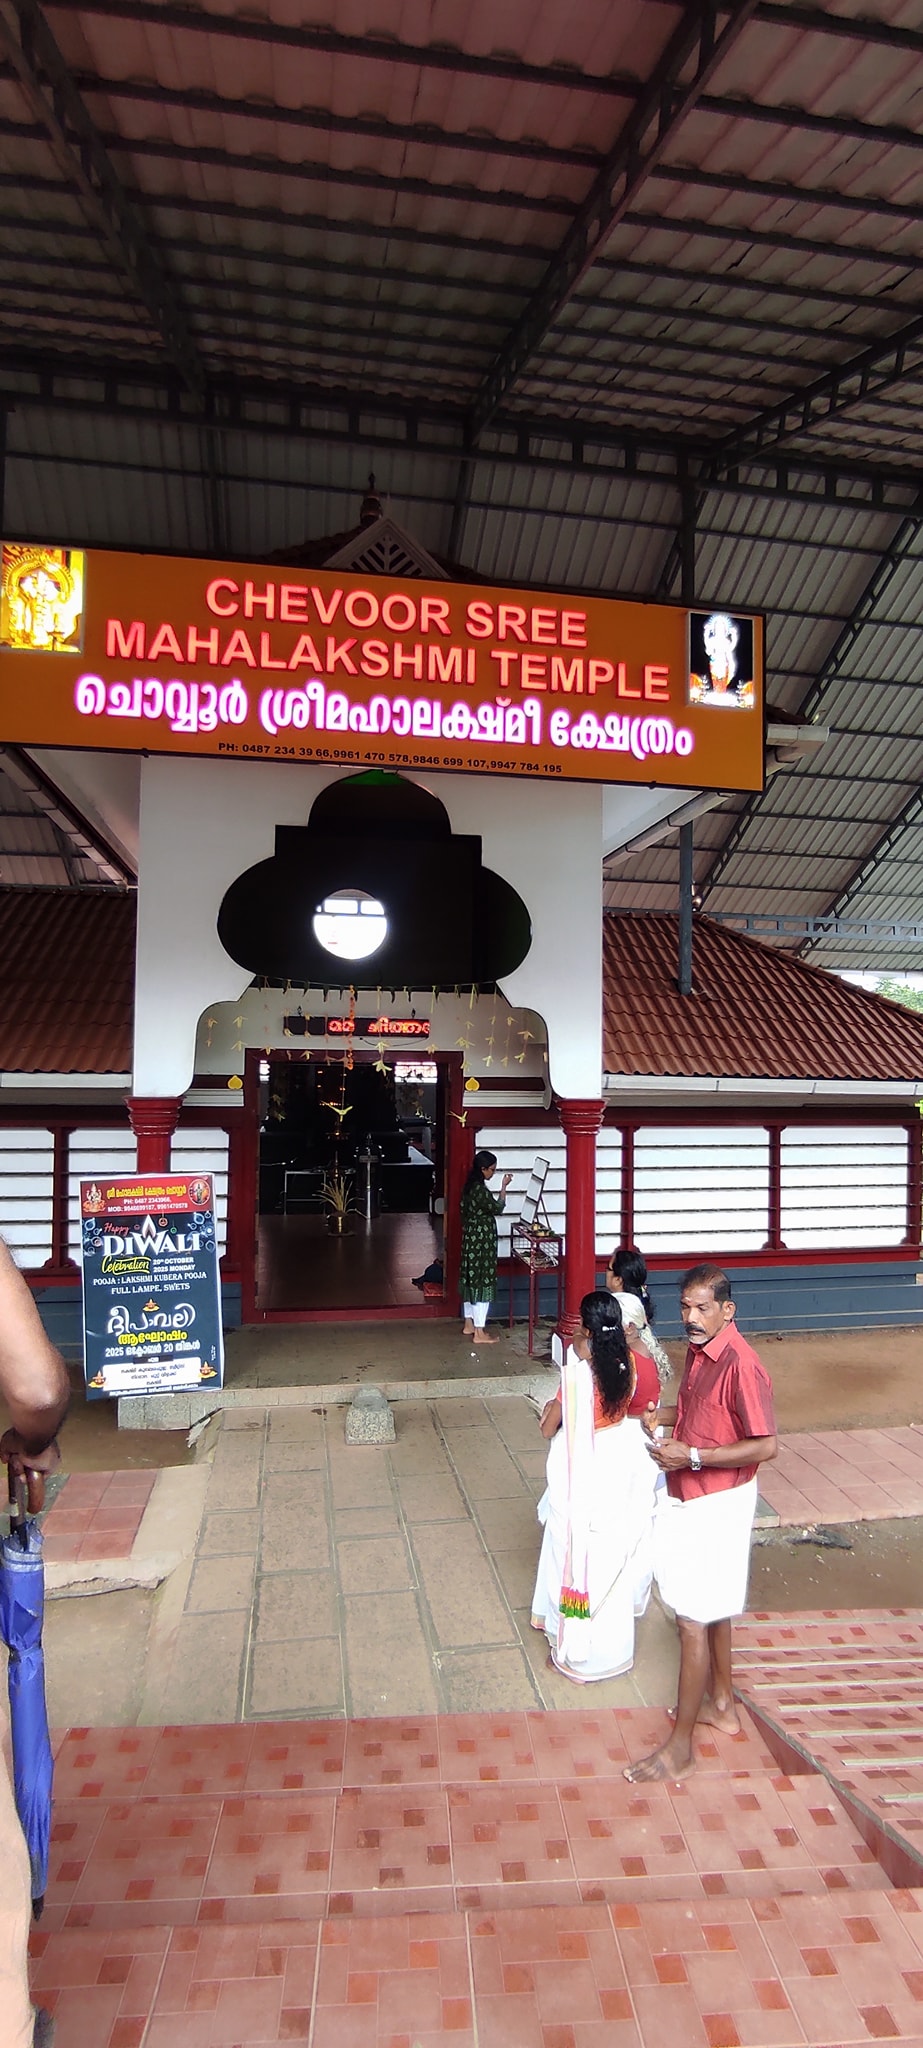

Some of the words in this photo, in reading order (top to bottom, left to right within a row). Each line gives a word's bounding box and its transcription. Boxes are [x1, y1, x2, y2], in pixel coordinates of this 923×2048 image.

[205, 578, 452, 636] CHEVOOR
[465, 601, 588, 648] SREE
[105, 619, 476, 686] MAHALAKSHMI
[490, 649, 671, 702] TEMPLE
[75, 674, 249, 733] ചൊവ്വൂർ
[550, 708, 695, 761] ക്ഷേത്രം
[218, 743, 239, 752] PH:
[242, 745, 271, 754] 0487
[274, 746, 295, 756] 234
[299, 747, 313, 757] 39
[316, 748, 360, 760] 66,9961
[364, 752, 385, 761] 470
[388, 753, 440, 766] 578,9846
[443, 757, 463, 767] 699
[467, 759, 517, 771] 107,9947
[520, 762, 540, 771] 784
[543, 764, 562, 773] 195
[104, 1222, 130, 1235] Happy
[102, 1255, 151, 1275] Celebration
[93, 1277, 116, 1285] POOJA
[122, 1275, 153, 1284] LAKSHMI
[154, 1273, 183, 1282] KUBERA
[184, 1271, 207, 1280] POOJA
[111, 1286, 131, 1295] FULL
[133, 1284, 162, 1294] LAMPE,
[107, 1303, 196, 1336] ദീപാവലി
[118, 1330, 187, 1346] ആഘോഷം
[105, 1347, 124, 1357] 2025
[164, 1343, 174, 1353] 20
